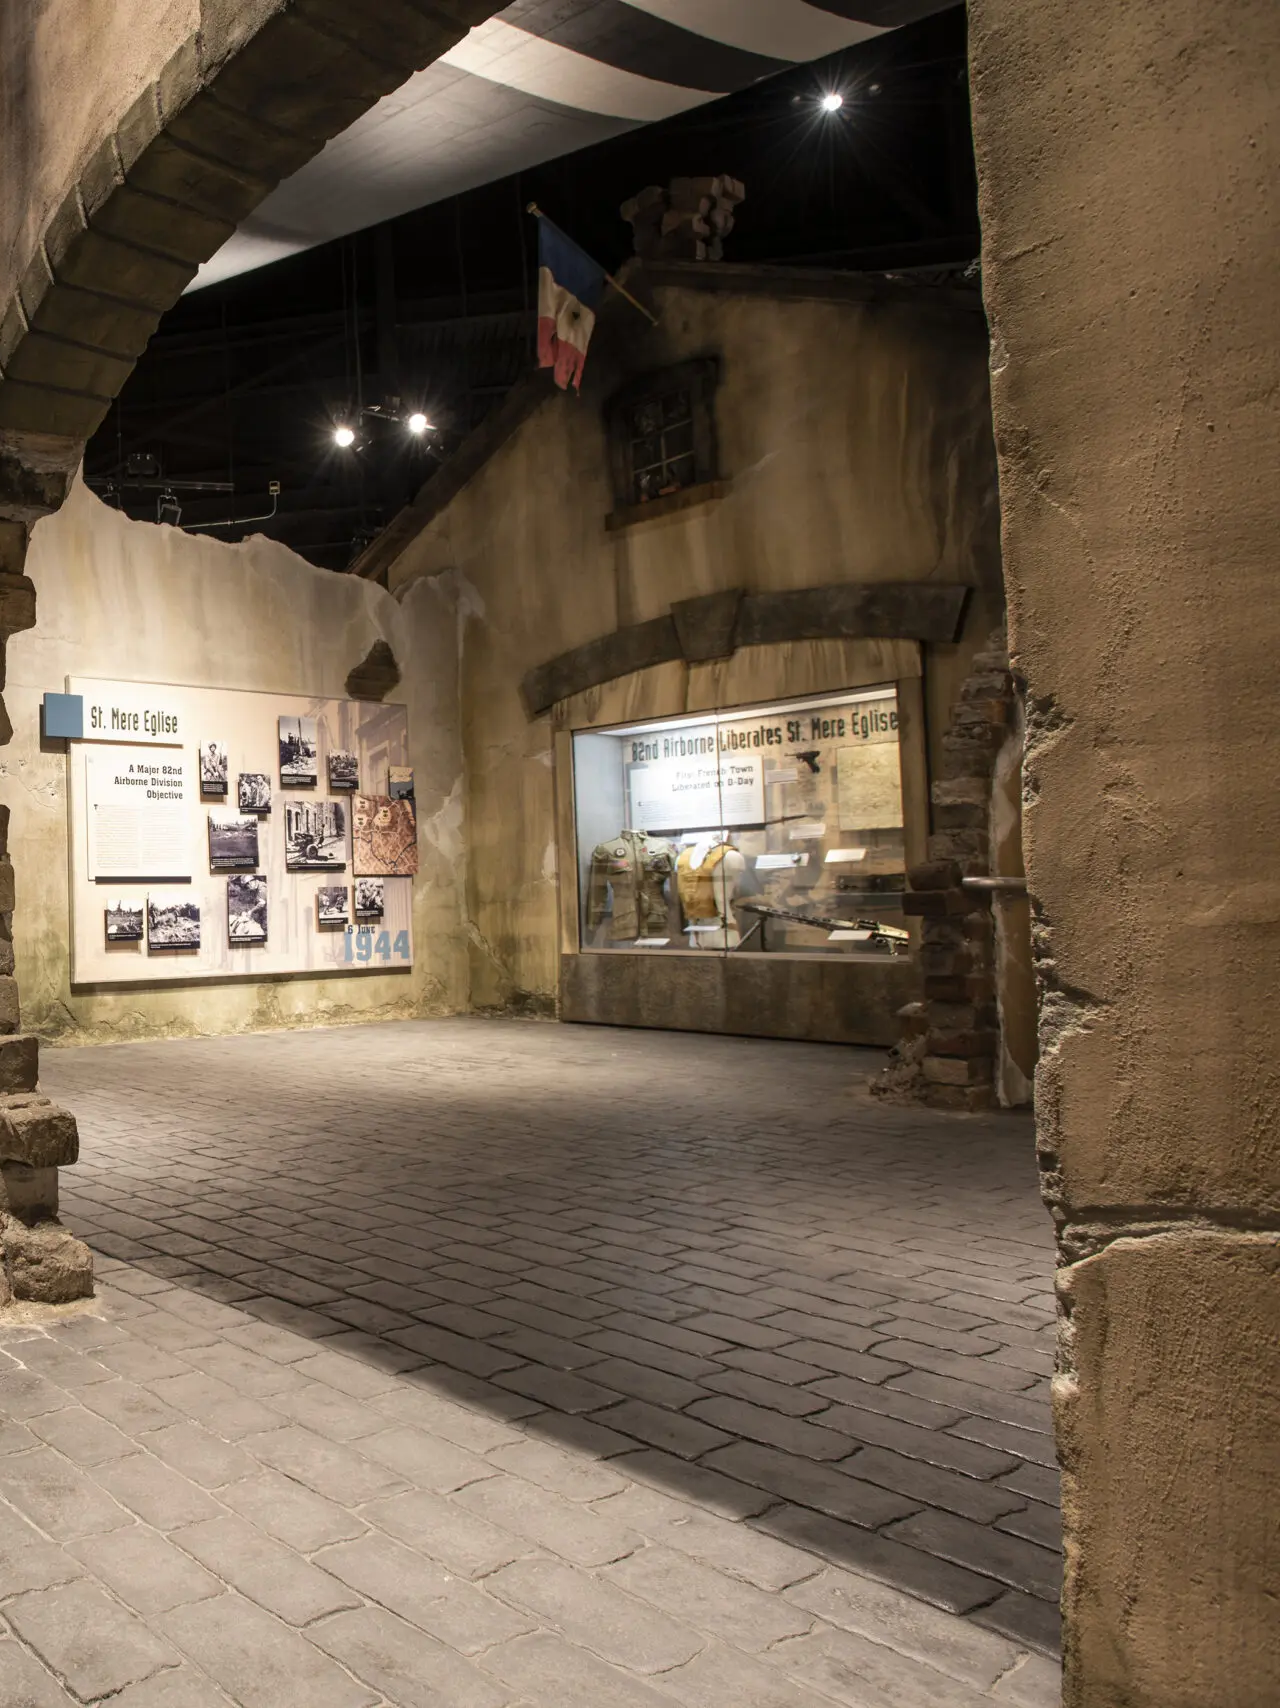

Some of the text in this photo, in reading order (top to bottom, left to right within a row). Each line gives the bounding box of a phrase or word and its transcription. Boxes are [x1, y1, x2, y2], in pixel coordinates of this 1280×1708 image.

[91, 706, 178, 736] St. Mere Eglise
[632, 709, 899, 761] 82nd Airborne Liberates St. Mere Eglise
[129, 764, 183, 775] A Major 82nd
[730, 765, 754, 774] Town
[114, 776, 183, 787] Airborne Division
[727, 777, 754, 786] D-Day
[146, 790, 183, 800] Objective
[347, 925, 353, 934] 6
[344, 930, 409, 962] 1944
